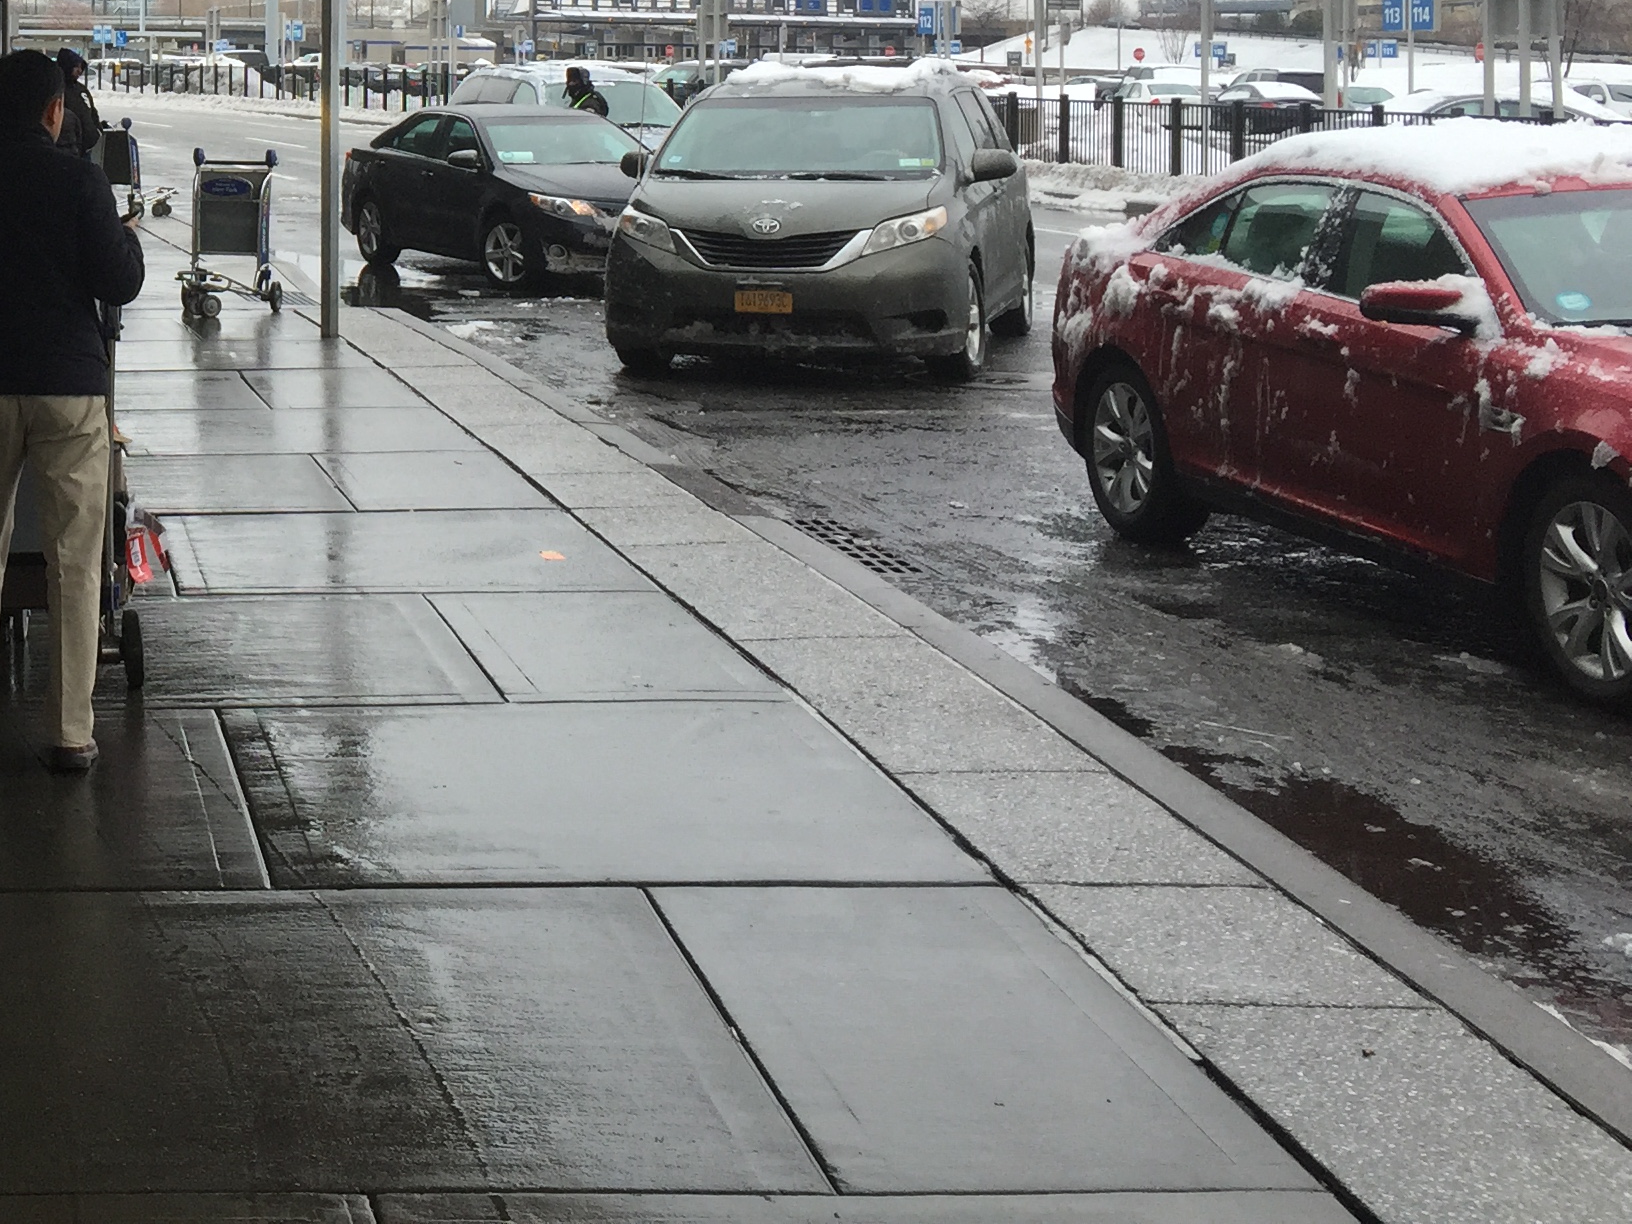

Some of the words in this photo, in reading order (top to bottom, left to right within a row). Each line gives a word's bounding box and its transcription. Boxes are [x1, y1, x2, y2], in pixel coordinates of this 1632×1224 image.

[919, 15, 932, 28] 112
[1384, 7, 1400, 24] 113
[1413, 6, 1430, 23] 114
